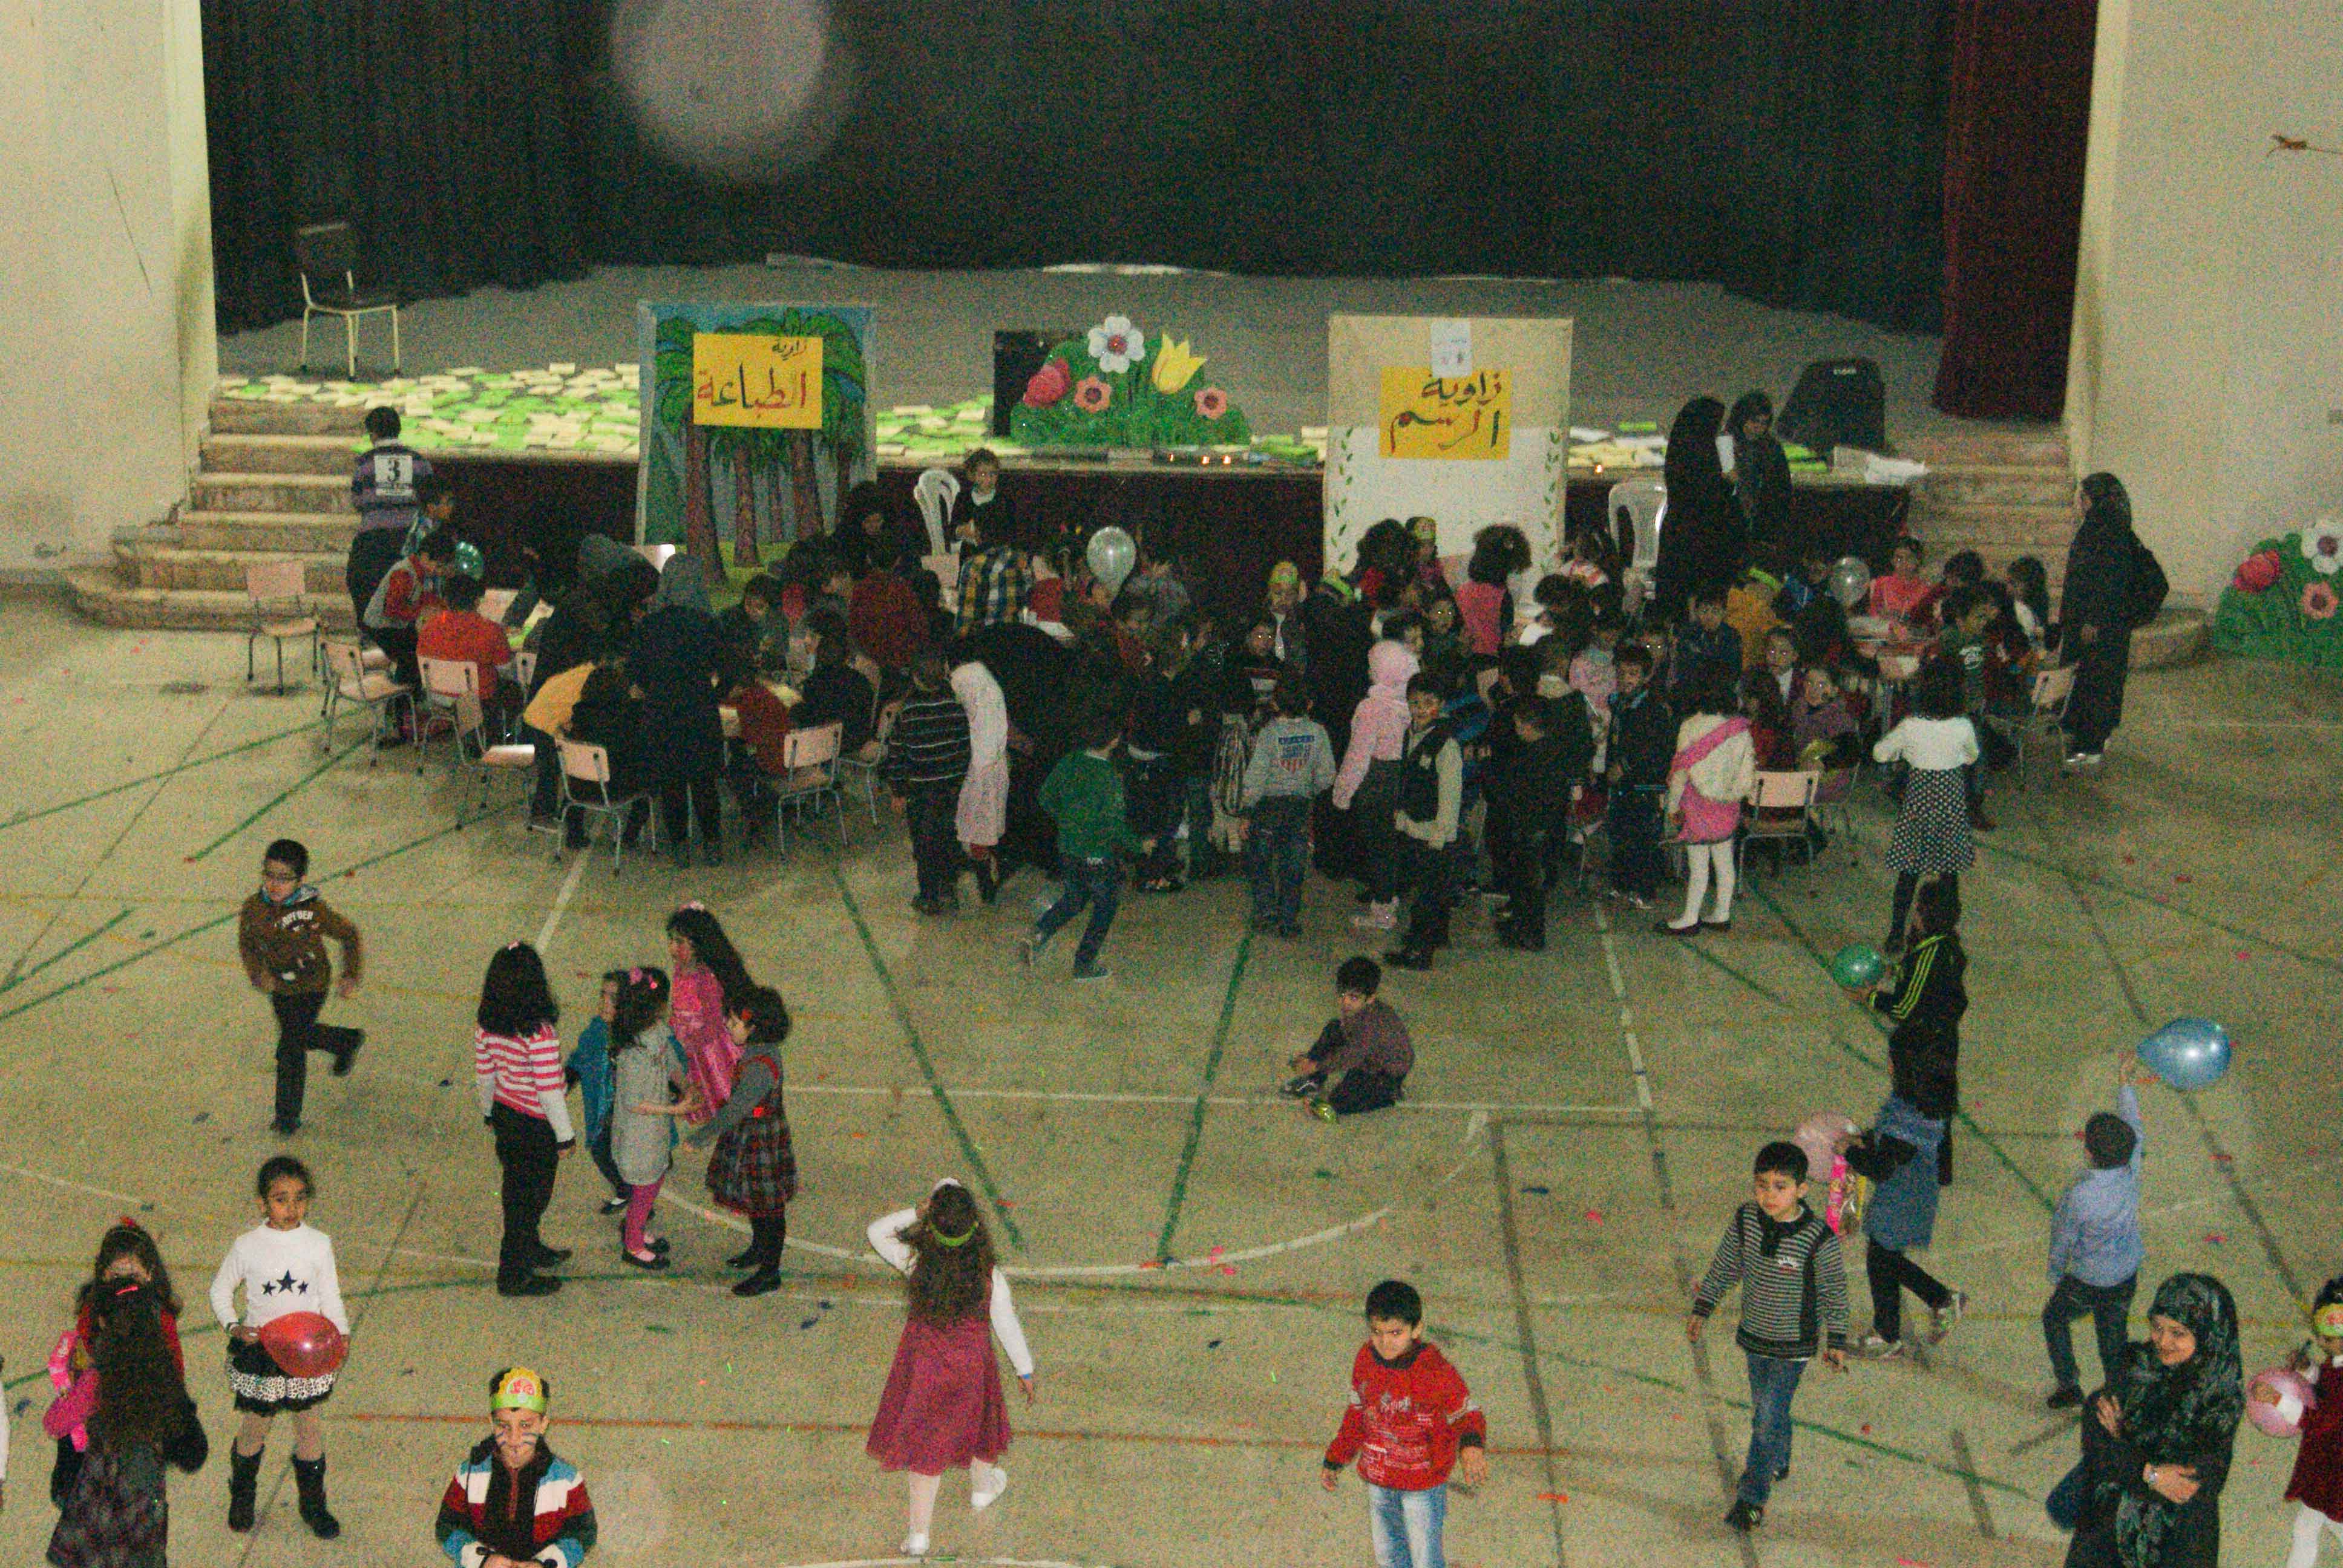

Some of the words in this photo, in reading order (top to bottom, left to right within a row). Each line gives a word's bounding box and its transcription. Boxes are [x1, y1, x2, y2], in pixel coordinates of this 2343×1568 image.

[696, 362, 807, 419] الطباعة
[1421, 372, 1503, 407] زاوية
[1389, 409, 1501, 454] الرسم
[387, 457, 401, 482] 3
